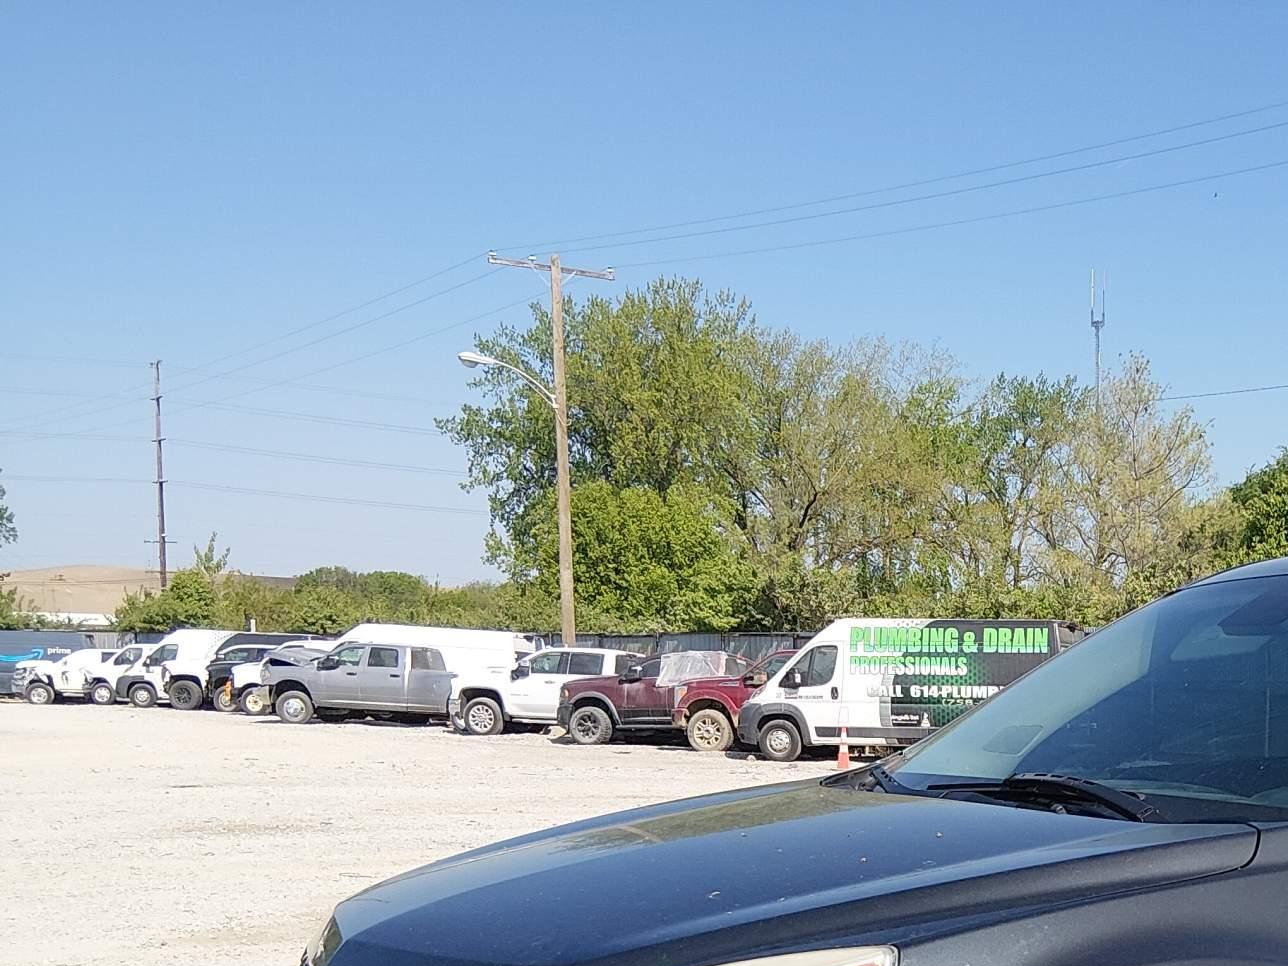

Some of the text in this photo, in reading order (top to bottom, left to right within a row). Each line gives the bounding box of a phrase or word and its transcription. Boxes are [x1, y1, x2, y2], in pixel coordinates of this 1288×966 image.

[850, 627, 1049, 654] PLUMBING & DRAIN
[47, 646, 72, 656] prime
[850, 656, 968, 676] PROFESSIONALS
[867, 685, 904, 698] CALL
